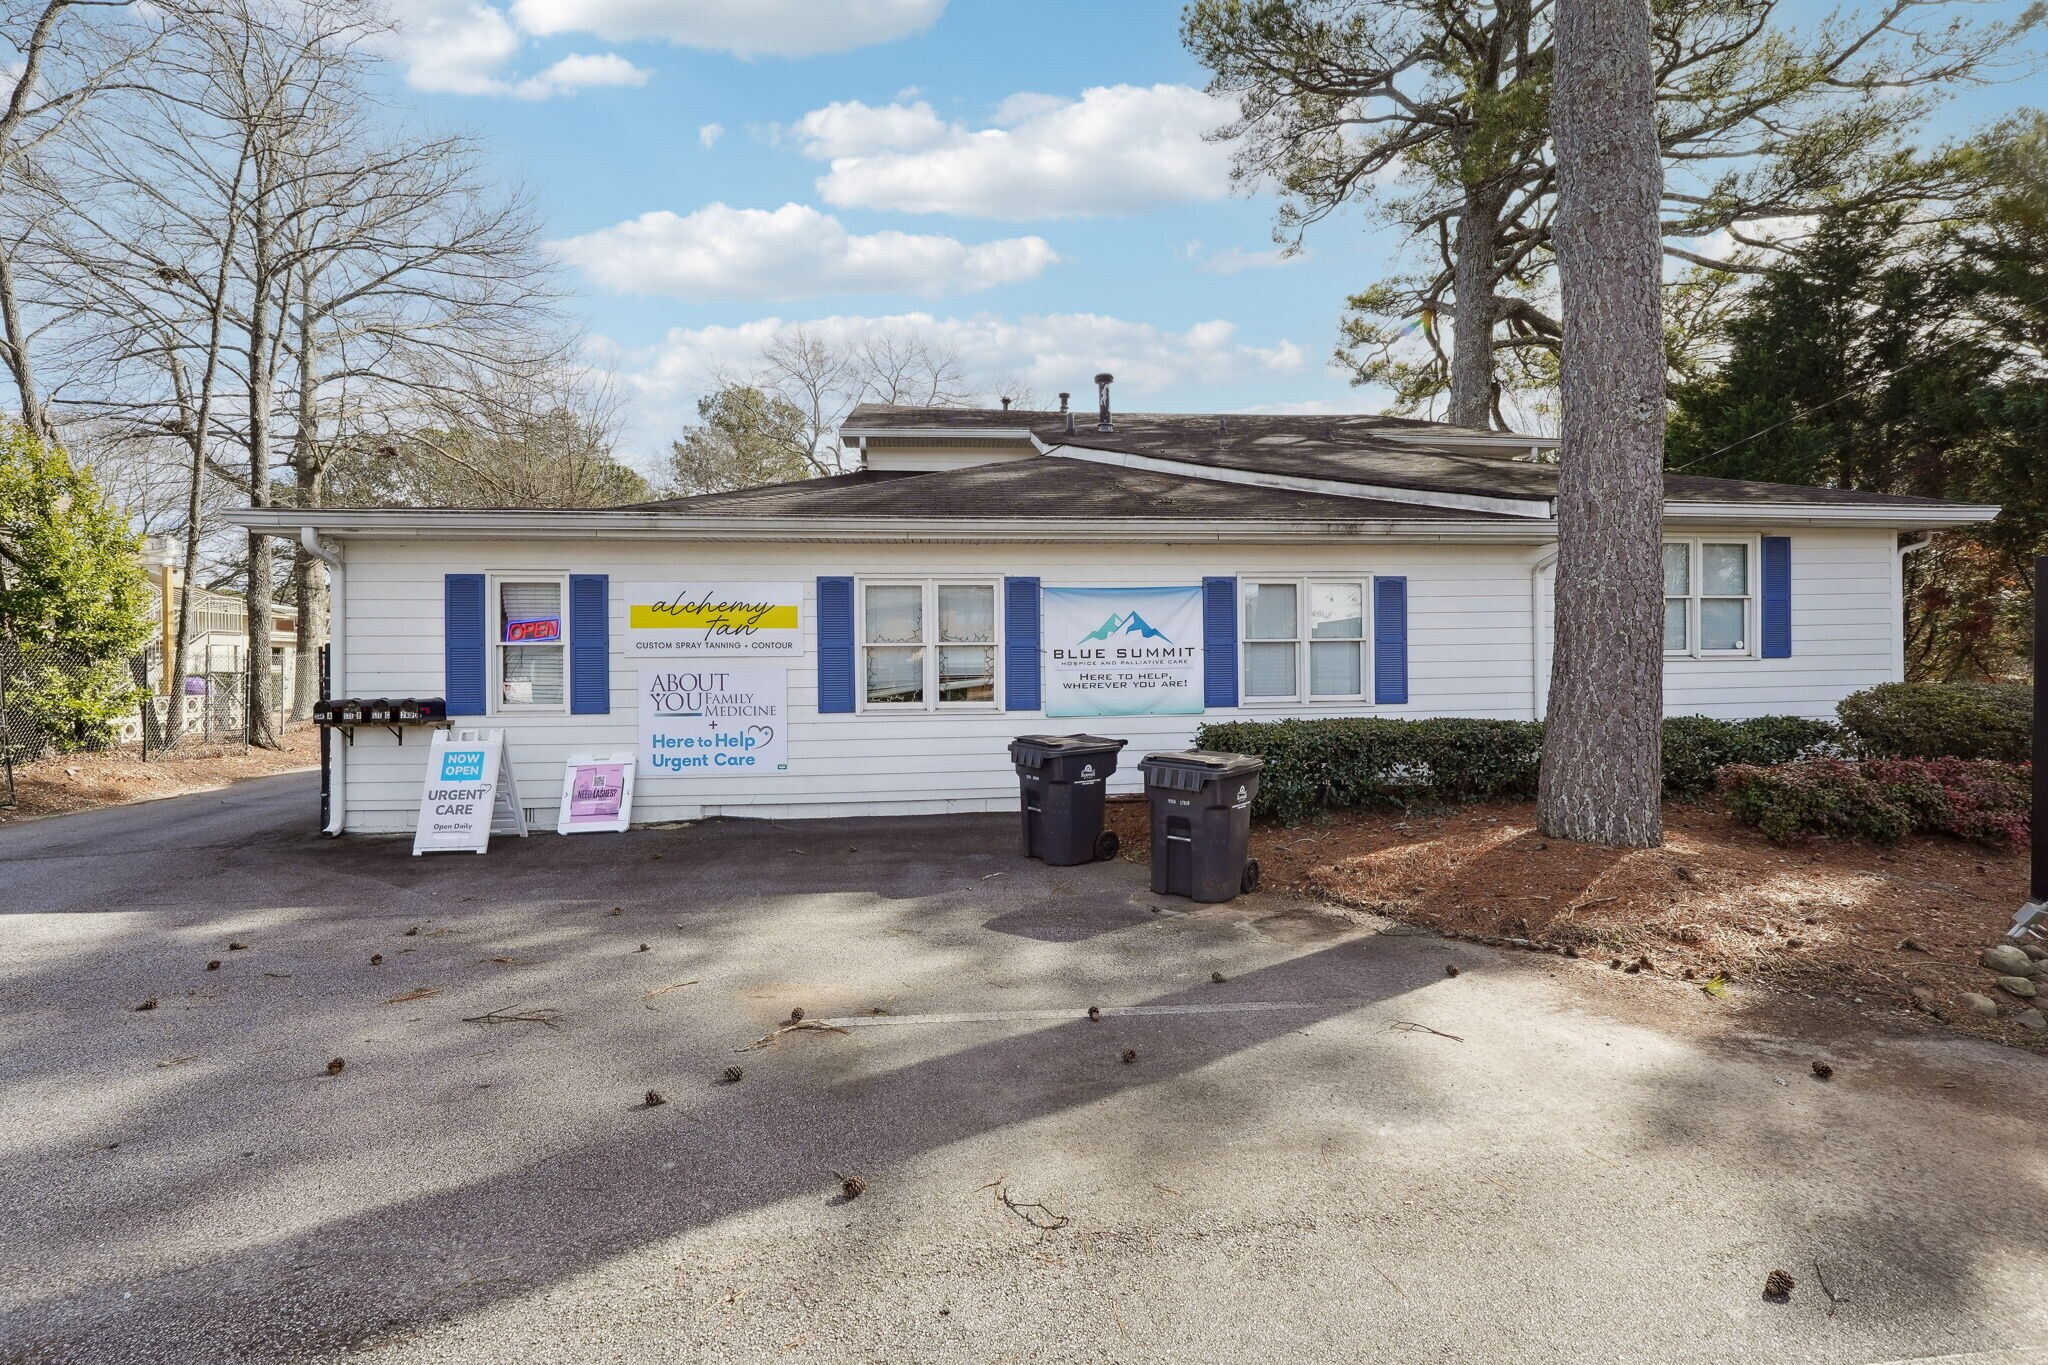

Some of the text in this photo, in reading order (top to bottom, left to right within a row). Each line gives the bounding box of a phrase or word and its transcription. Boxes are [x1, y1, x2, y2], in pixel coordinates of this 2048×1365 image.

[652, 591, 775, 624] alchemy
[509, 620, 558, 640] OPEN
[705, 614, 758, 641] tan
[1054, 648, 1195, 659] BLUE SUMMIT
[1138, 672, 1172, 680] HELP,
[651, 673, 730, 692] ABOUT
[650, 692, 754, 712] YOU FAMILY
[704, 706, 776, 717] MEDICINE
[652, 731, 756, 750] Here to Help
[448, 754, 480, 764] NOW
[652, 752, 756, 772] Urgent Care
[446, 766, 479, 776] OPEN
[428, 790, 486, 800] URGENT
[578, 788, 618, 799] NEED LASHES?
[435, 804, 474, 816] CARE
